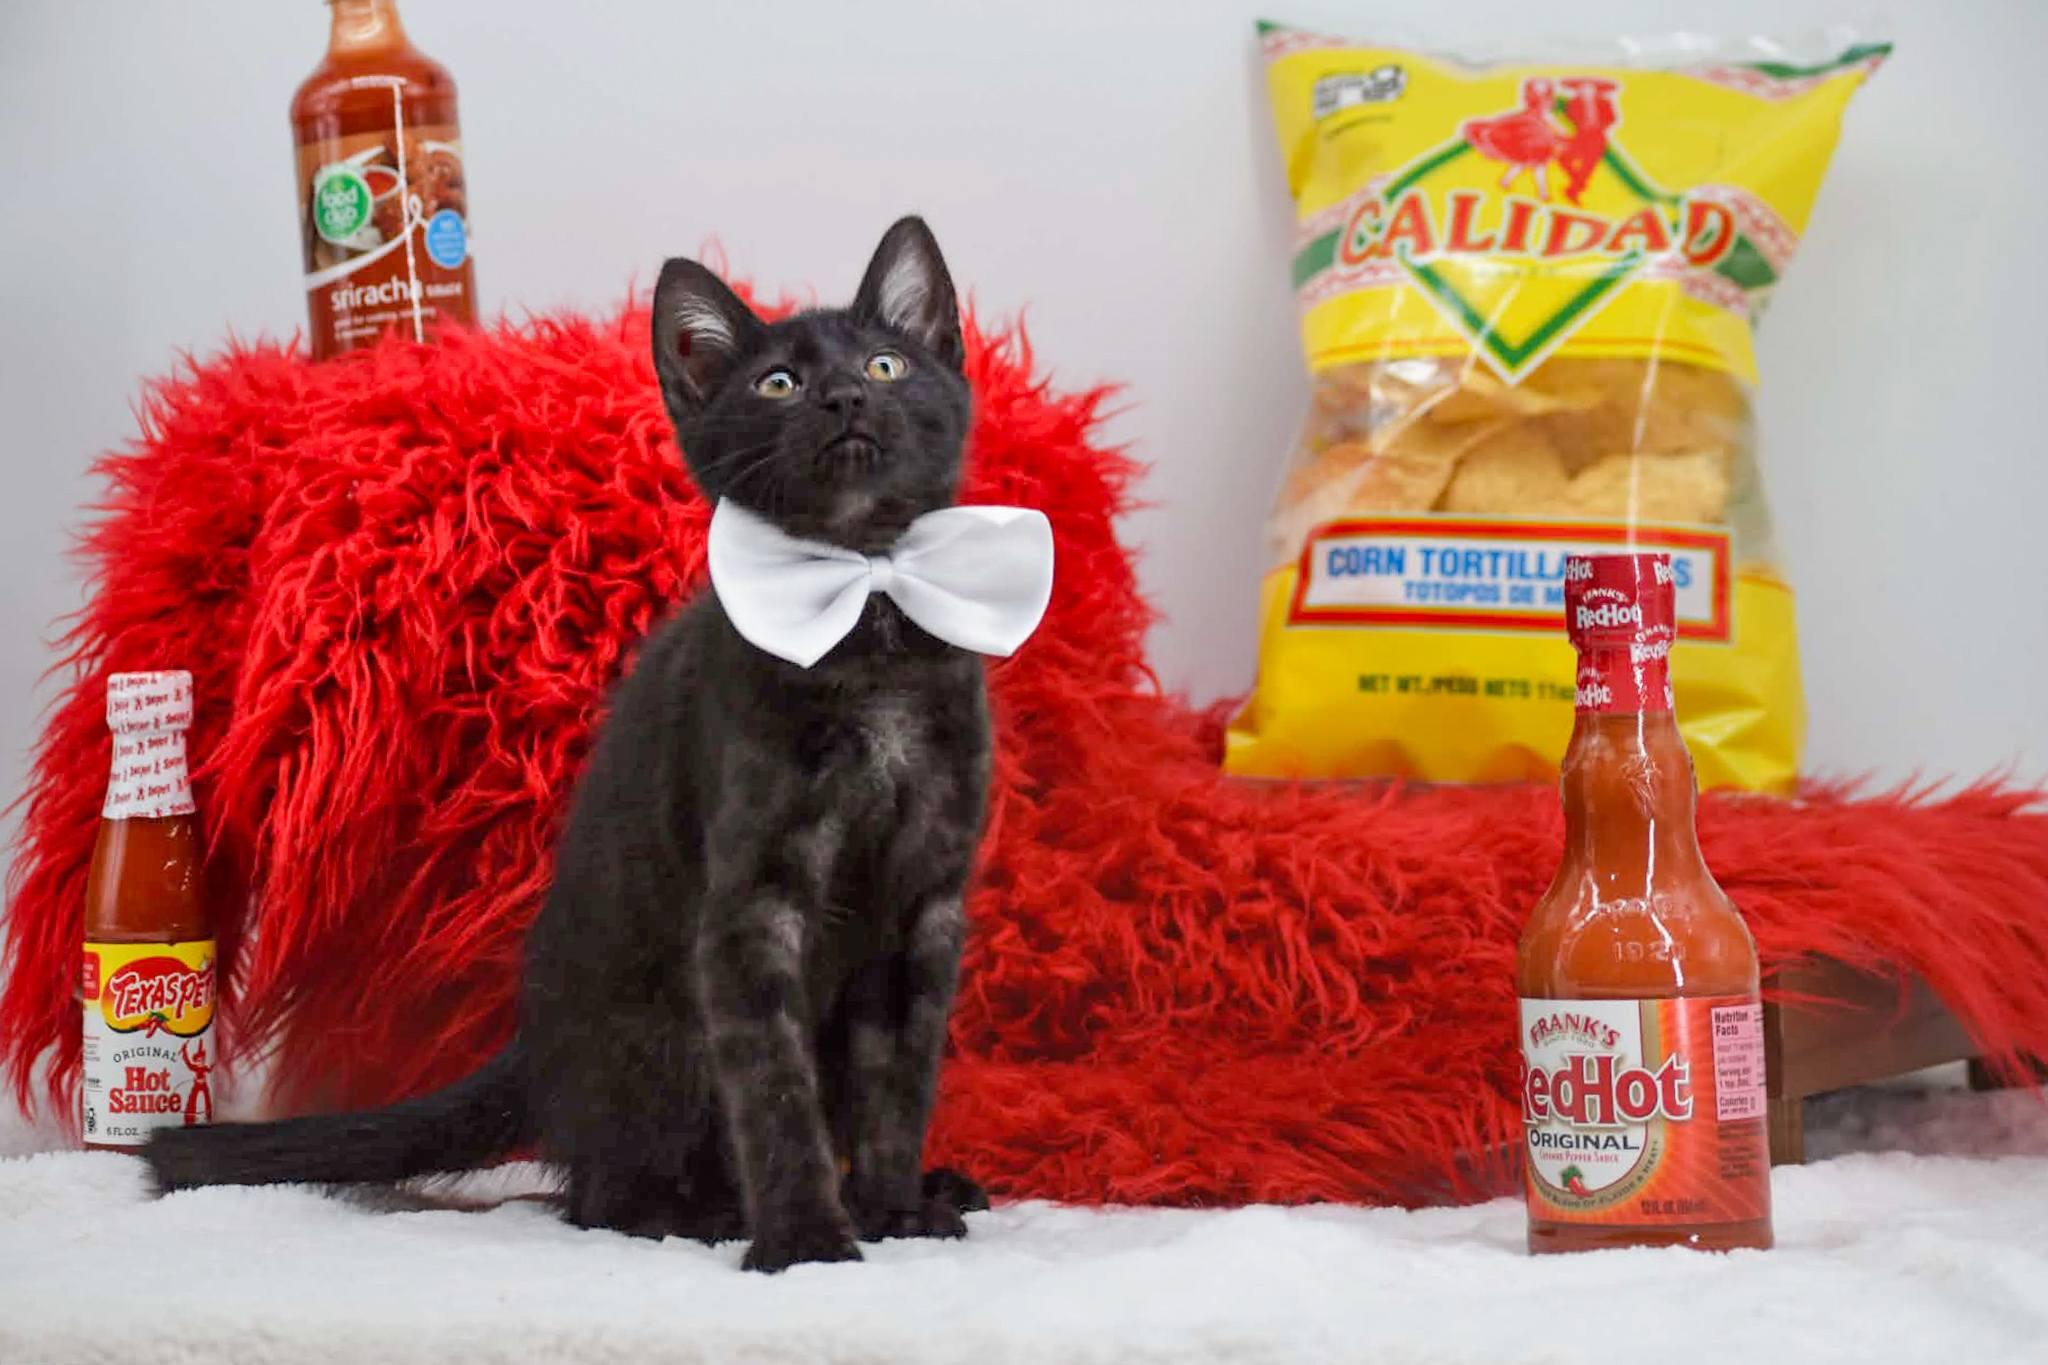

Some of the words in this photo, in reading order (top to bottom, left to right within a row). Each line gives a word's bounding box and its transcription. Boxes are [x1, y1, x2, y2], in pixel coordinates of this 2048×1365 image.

[1338, 193, 1735, 268] CALIDAD
[1328, 546, 1404, 577] CORN
[1714, 1011, 1748, 1024] Nutrition
[1715, 1024, 1739, 1036] Facts
[1530, 1013, 1621, 1048] FRANK'S
[113, 1046, 177, 1063] ORIGINAL
[125, 1067, 171, 1092] Hot
[109, 1088, 182, 1114] Sauce
[1530, 1129, 1640, 1150] ORIGINAL
